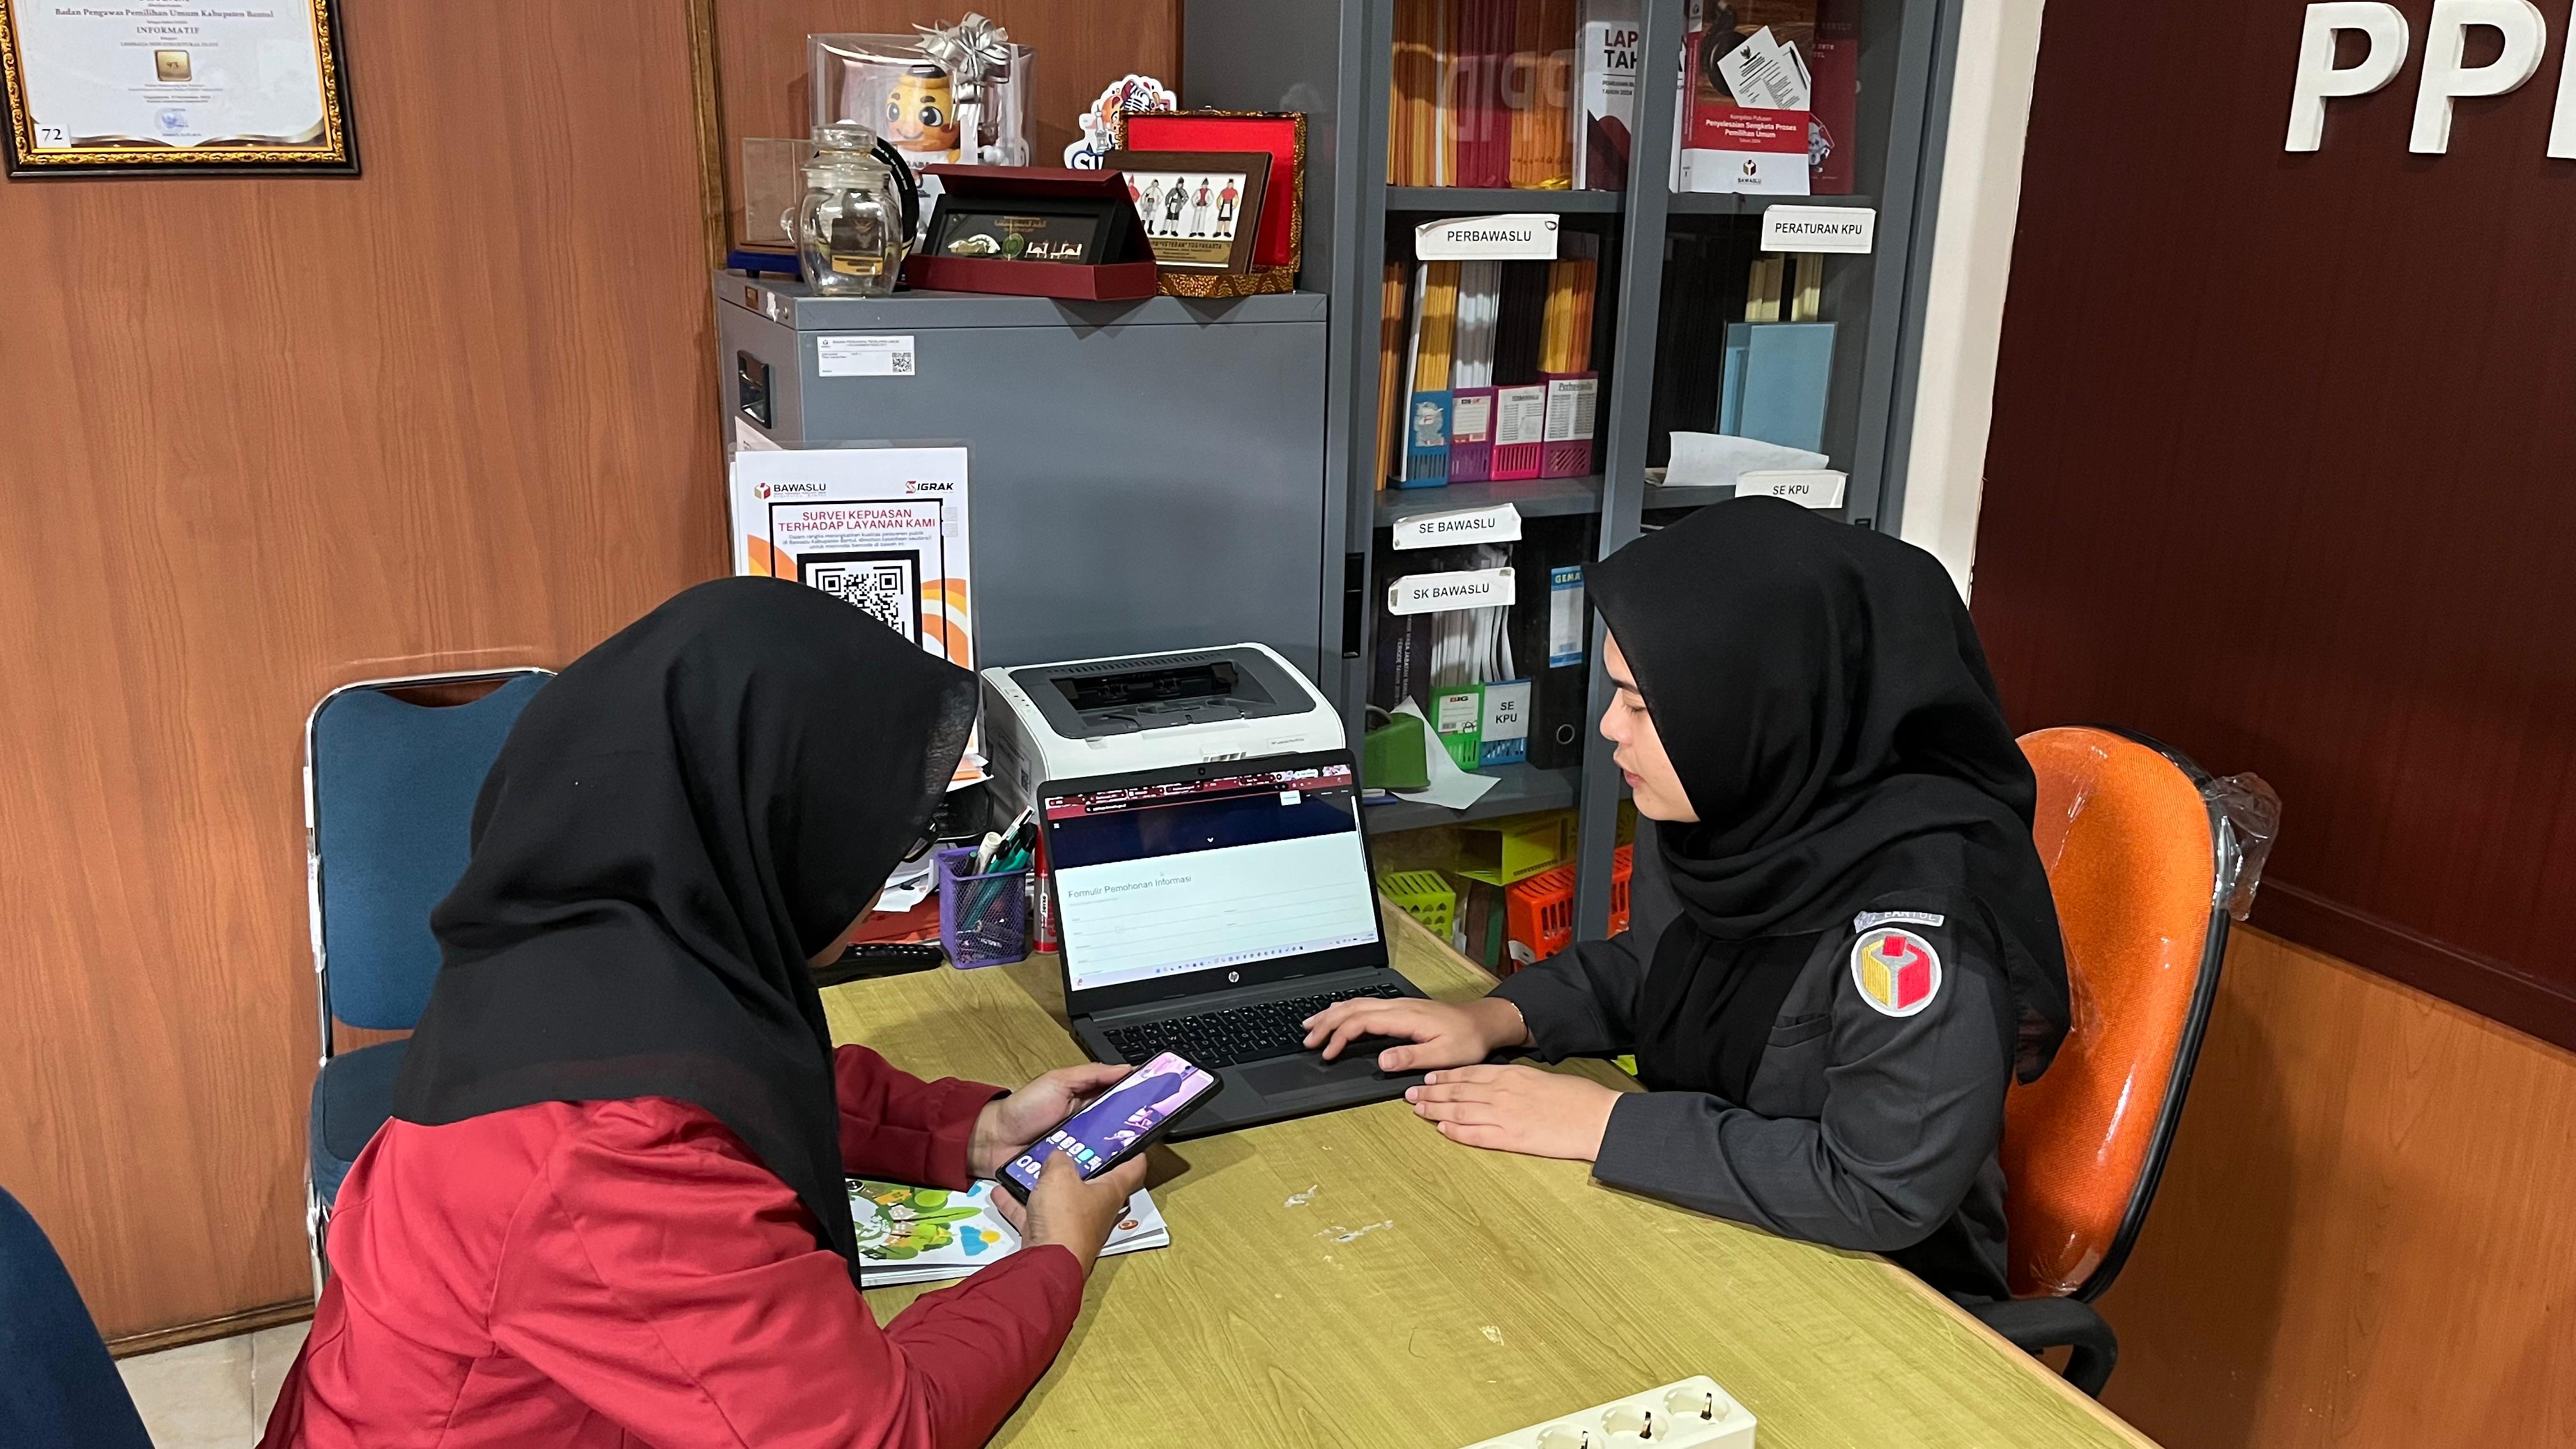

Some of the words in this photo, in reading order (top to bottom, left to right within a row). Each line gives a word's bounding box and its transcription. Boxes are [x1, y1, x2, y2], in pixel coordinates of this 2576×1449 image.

[84, 9, 124, 18] Pengawas
[1705, 119, 1745, 128] Penyelesaian
[1745, 122, 1775, 130] Sengketa
[42, 128, 63, 142] 72
[1725, 128, 1755, 137] Pemilihan
[1775, 222, 1839, 236] PERATURAN
[1841, 224, 1863, 236] KPU
[1446, 230, 1532, 243] PERBAWASLU
[773, 483, 826, 492] BAWASLU
[905, 480, 954, 494] SIGRAK
[1772, 485, 1787, 496] SE
[1789, 484, 1810, 496] KPU
[802, 510, 846, 521] SURVEI
[848, 509, 912, 519] KEPUASAN
[778, 521, 843, 532] TERHADAP
[847, 519, 903, 530] LAYANAN
[905, 518, 935, 528] KAMI
[1419, 522, 1435, 534] SE
[1438, 517, 1496, 532] BAWASLU
[1554, 572, 1581, 584] GEMA
[1413, 588, 1430, 599] SK
[1432, 583, 1490, 598] BAWASLU
[1500, 701, 1515, 711] SE
[1495, 713, 1517, 724] KPU
[1068, 887, 1102, 898] Formulir
[1104, 881, 1153, 894] Pemohonan
[1155, 875, 1192, 887] Informasi
